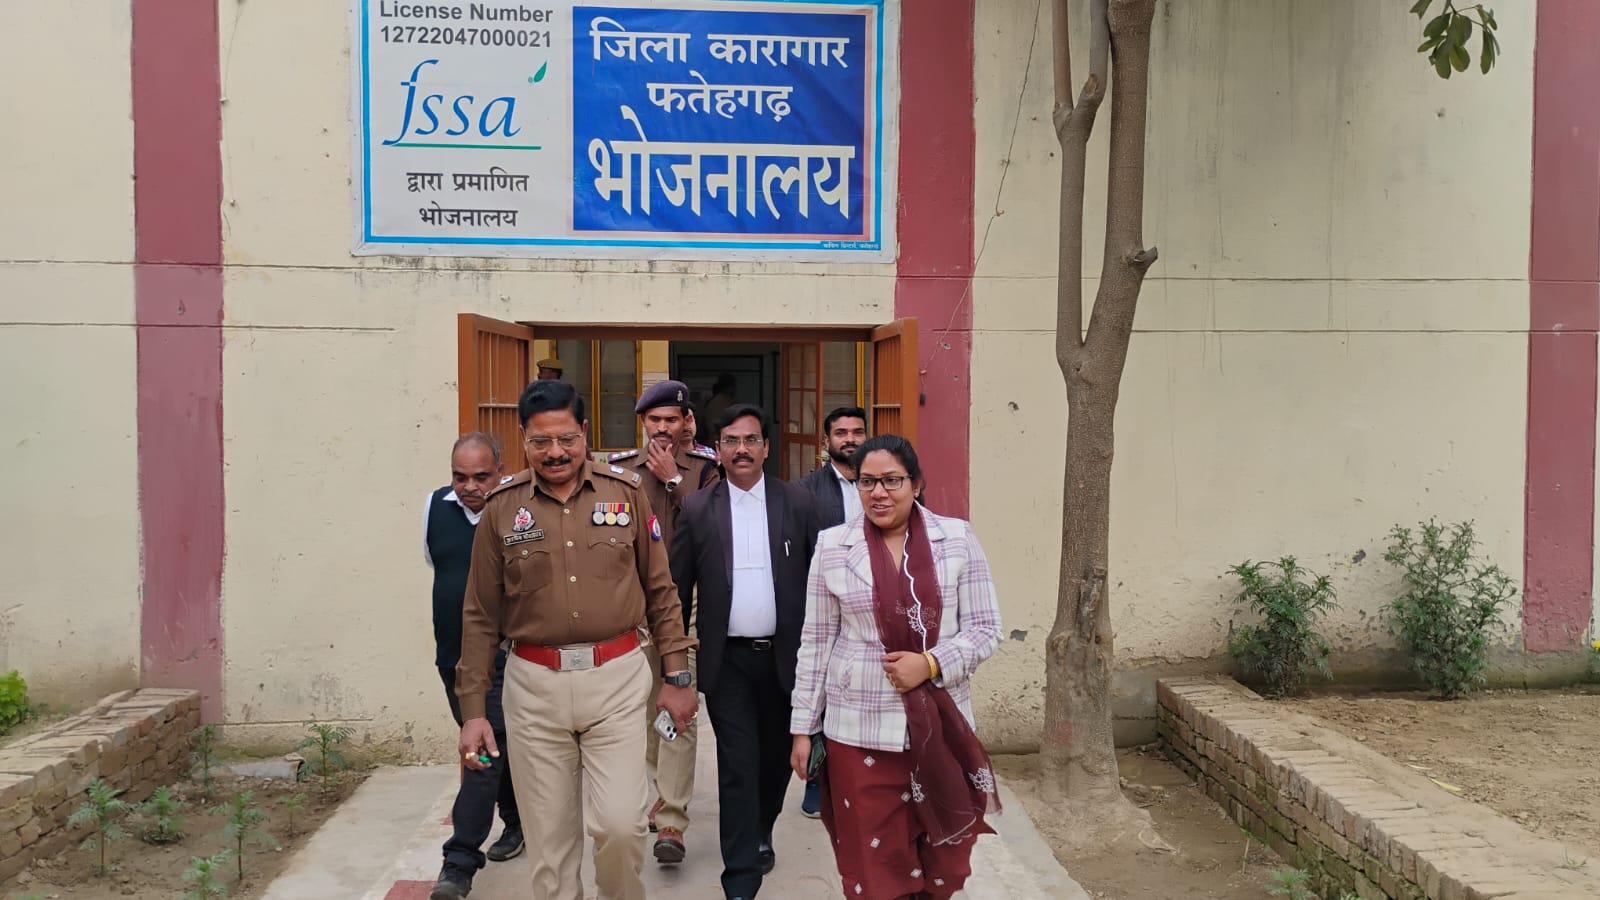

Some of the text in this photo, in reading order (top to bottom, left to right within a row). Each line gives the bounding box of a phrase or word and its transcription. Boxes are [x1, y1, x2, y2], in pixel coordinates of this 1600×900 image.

[380, 0, 553, 23] License Number
[380, 25, 551, 48] 12722047000021
[589, 16, 850, 69] जिला कारागार
[646, 69, 794, 122] फतेहगढ़
[588, 104, 856, 220] भोजनालय
[406, 166, 530, 193] द्वारा प्रमाणित
[419, 200, 519, 227] भोजनालय
